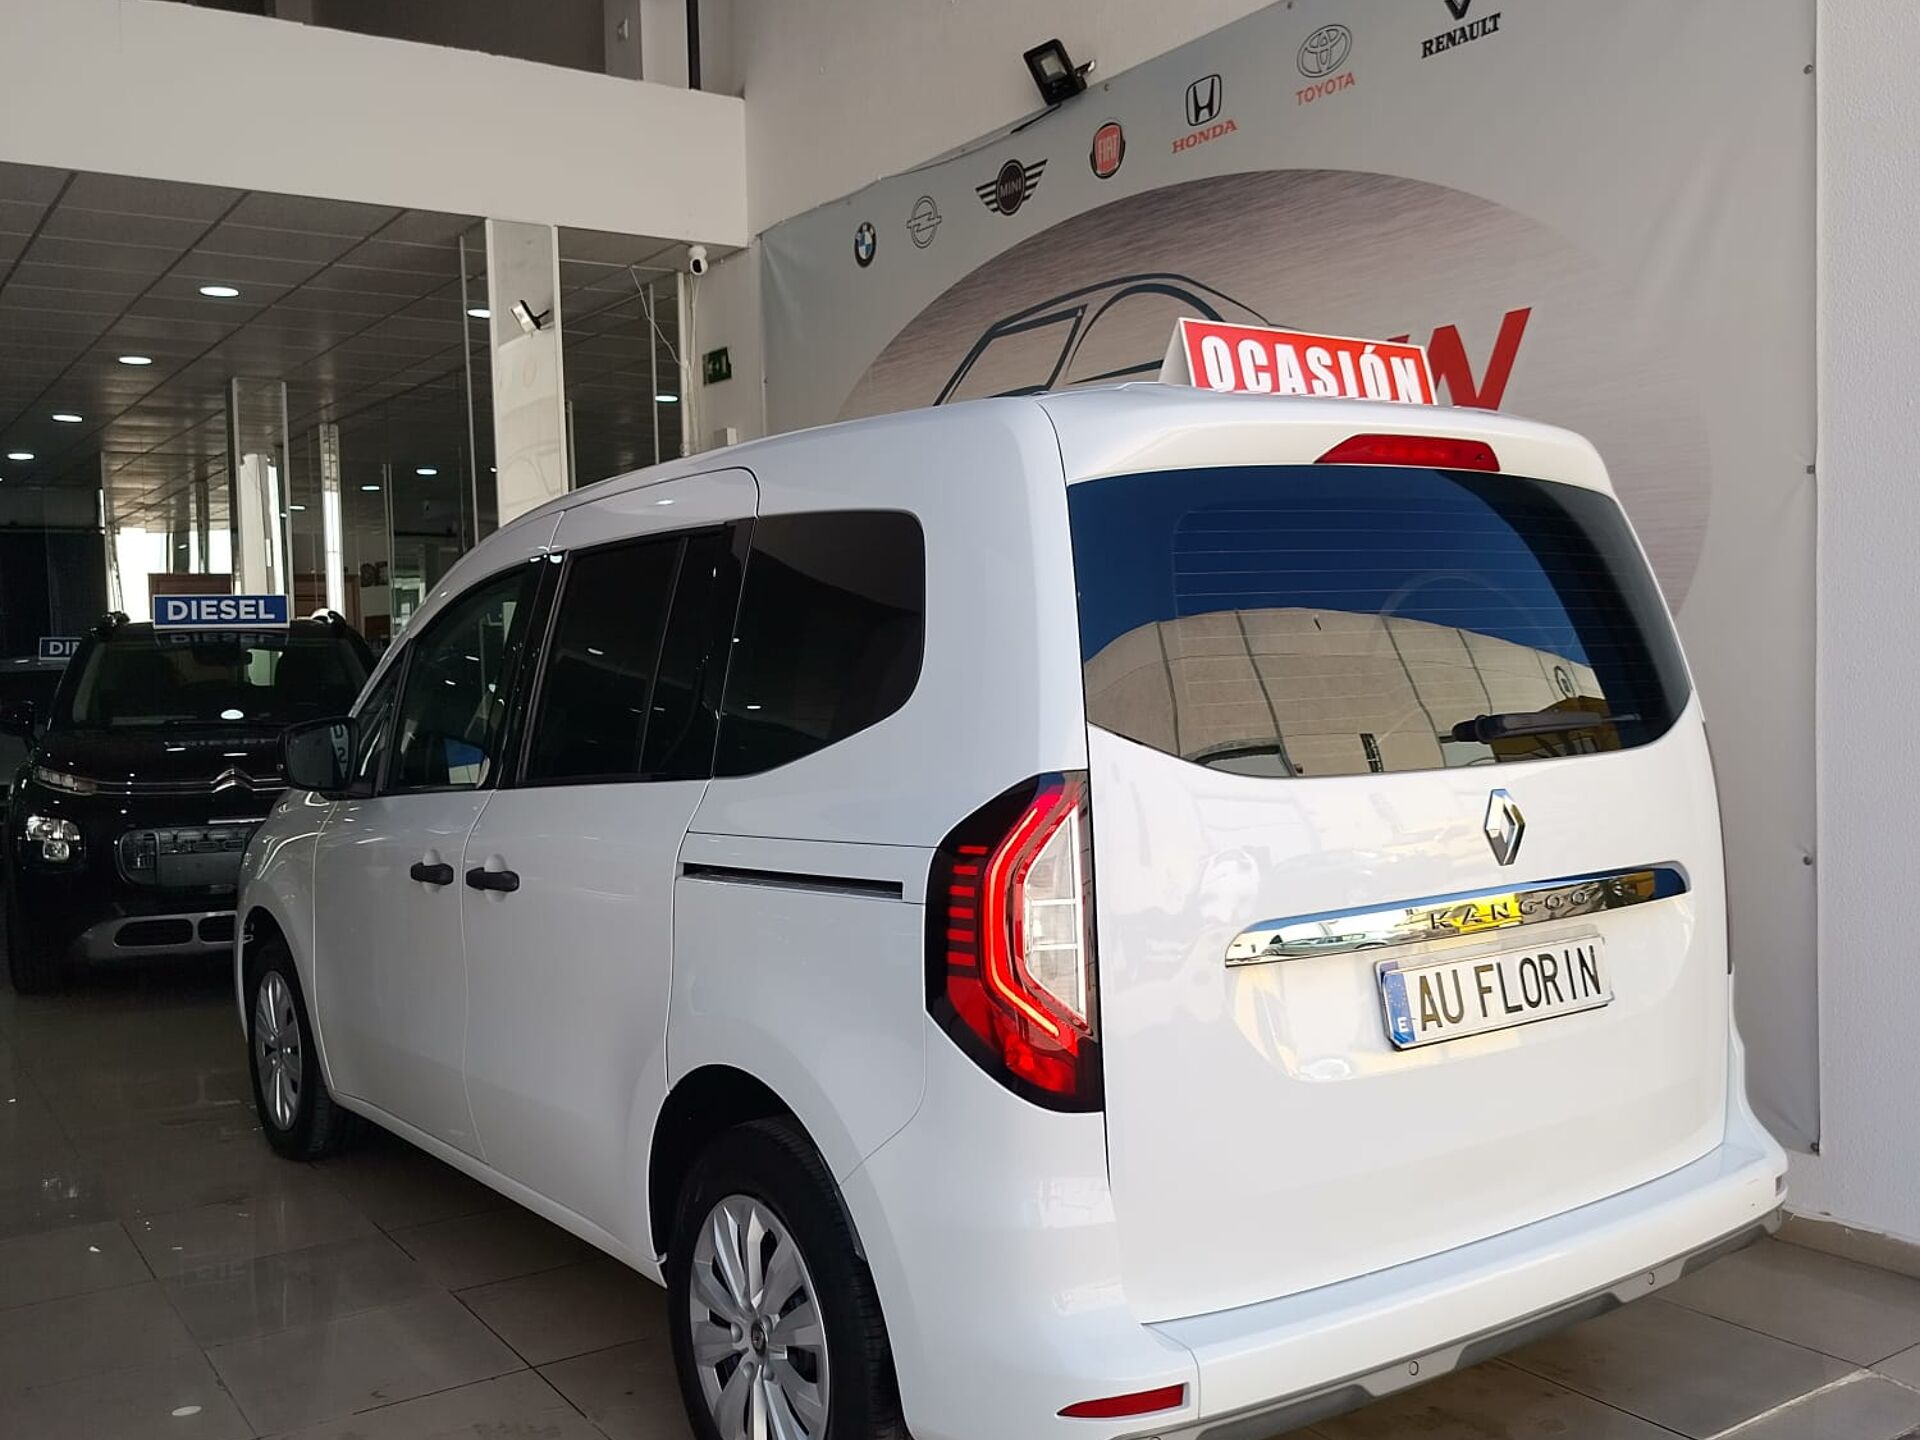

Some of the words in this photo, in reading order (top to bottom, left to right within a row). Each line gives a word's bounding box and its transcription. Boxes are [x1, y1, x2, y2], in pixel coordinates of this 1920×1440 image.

[1421, 12, 1501, 59] RENAULT
[1296, 72, 1355, 106] TOYOTA
[1172, 119, 1237, 153] HONDA
[1000, 177, 1022, 198] MINI
[1201, 334, 1422, 405] OCASIÓN
[167, 600, 275, 621] DIESEL
[1431, 889, 1588, 930] KANGOO
[1419, 969, 1464, 1031] AU
[1474, 945, 1602, 1018] FLORIN
[1397, 1016, 1408, 1032] E
